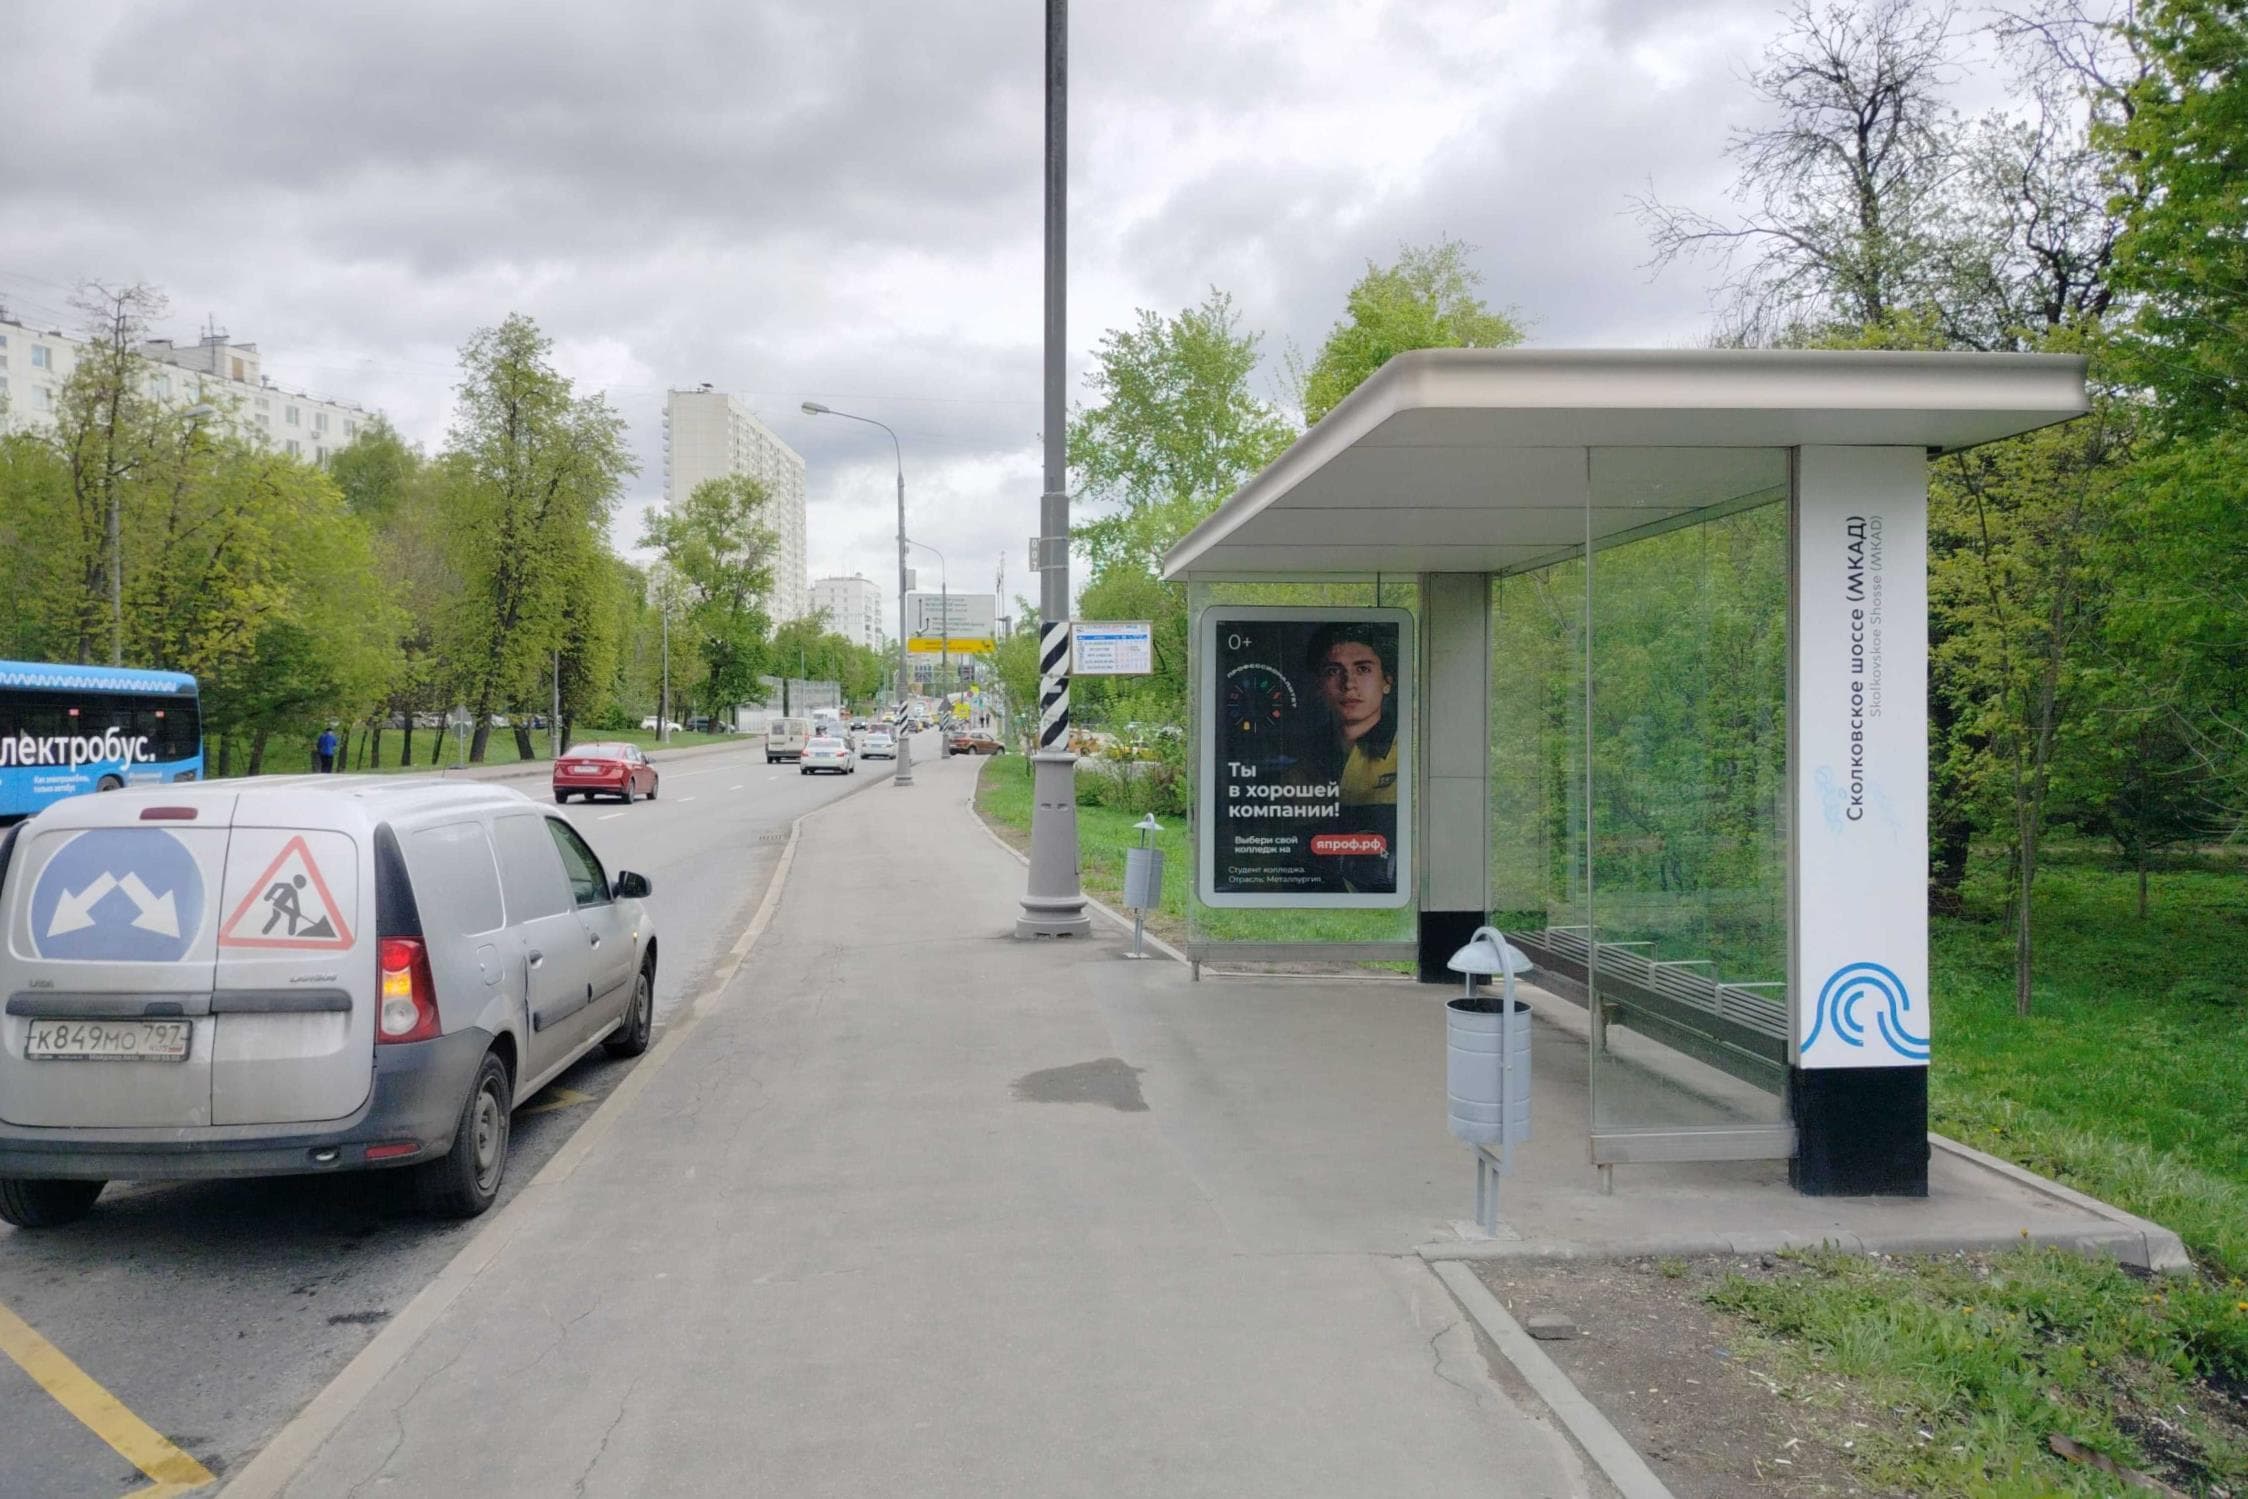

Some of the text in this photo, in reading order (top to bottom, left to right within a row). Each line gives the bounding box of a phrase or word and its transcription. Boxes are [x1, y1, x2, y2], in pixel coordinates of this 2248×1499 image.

[1870, 515, 1883, 717] Skolkovskoe Shosse (MKAD)
[1228, 634, 1252, 650] 0+
[1846, 515, 1867, 821] Сколковское шоссе (МКАД)
[0, 726, 156, 772] лектробус.
[1228, 762, 1256, 778] Ты
[1229, 781, 1340, 801] в хорошей
[1229, 802, 1340, 818] компании!
[1235, 835, 1298, 845] Выбери свой
[1316, 838, 1381, 851] япроф.рф
[1235, 846, 1277, 854] колледж
[1228, 866, 1262, 874] Студент
[143, 1024, 181, 1045] 797
